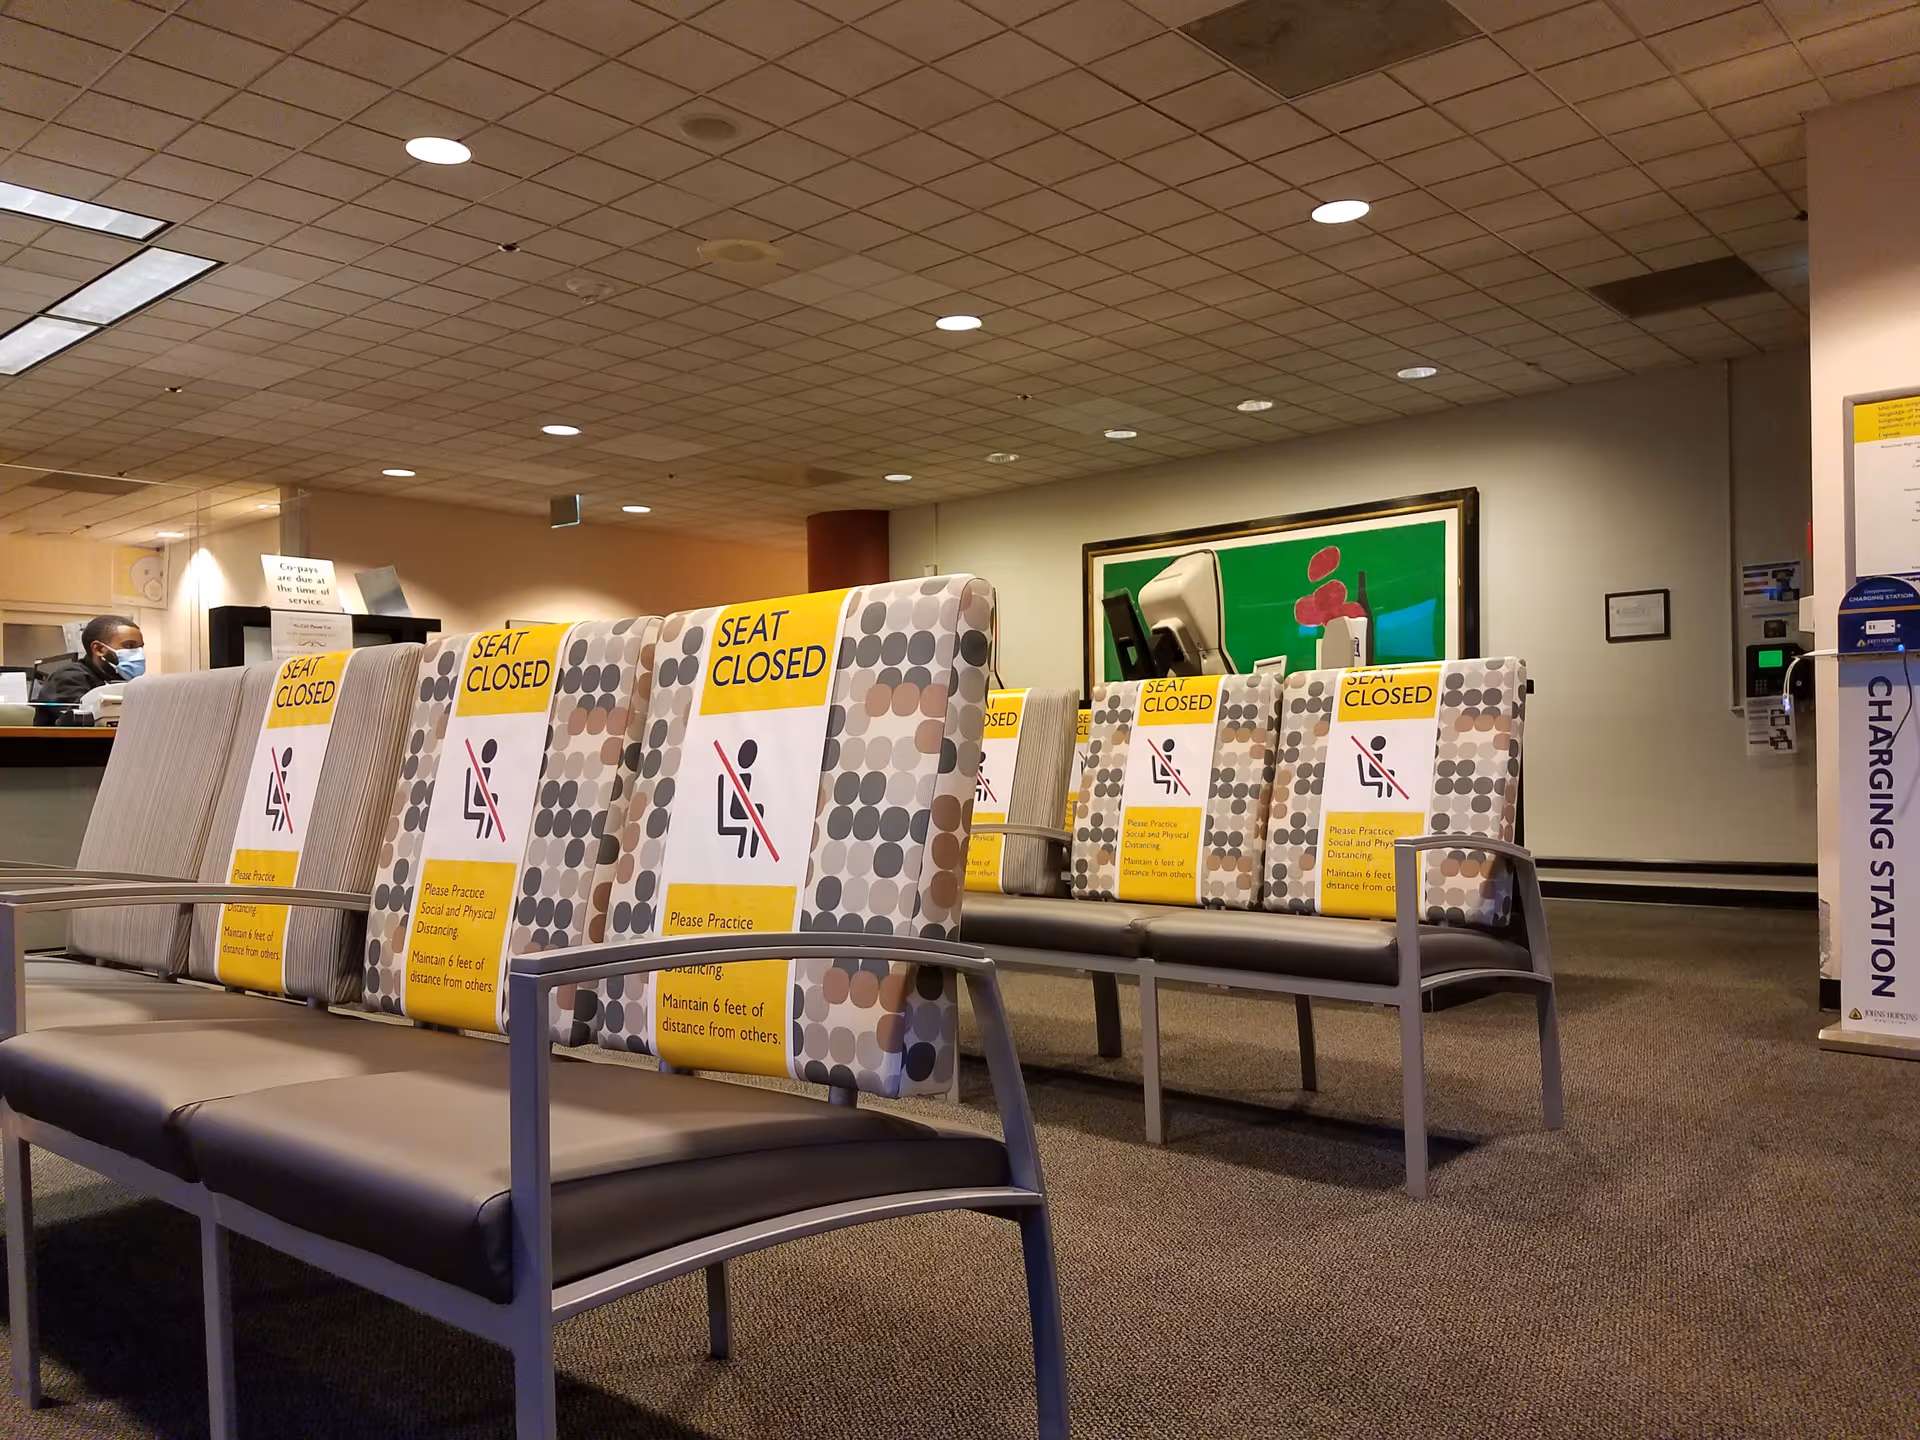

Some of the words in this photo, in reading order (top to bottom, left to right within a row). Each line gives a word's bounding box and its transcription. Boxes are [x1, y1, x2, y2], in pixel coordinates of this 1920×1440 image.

[279, 562, 319, 574] Co-pays
[296, 575, 313, 583] due
[277, 584, 293, 593] the
[296, 586, 317, 595] time
[1848, 594, 1884, 602] CHARGING
[1885, 592, 1915, 600] STATION
[718, 609, 790, 648] SEAT
[473, 631, 530, 659] SEAT
[283, 656, 326, 679] SEAT
[712, 645, 827, 687] CLOSED
[466, 660, 550, 692] CLOSED
[1346, 667, 1402, 686] SEAT
[276, 680, 336, 708] CLOSED
[1145, 678, 1190, 694] SEAT
[1143, 694, 1213, 713] CLOSED
[1344, 685, 1433, 707] CLOSED
[984, 711, 1018, 727] OSED
[1078, 713, 1091, 724] SE
[1868, 675, 1895, 850] CHARGING
[1127, 819, 1148, 827] Please
[1150, 820, 1178, 828] Practice
[1329, 826, 1356, 835] Please
[1359, 826, 1394, 836] Practice
[1126, 829, 1146, 838] Social
[1162, 831, 1190, 840] Physical
[1328, 838, 1353, 847] Social
[1356, 839, 1371, 847] and
[1374, 839, 1395, 850] Phys
[1123, 857, 1152, 865] Maintain
[1161, 859, 1175, 867] feet
[1177, 859, 1185, 867] of
[234, 869, 251, 881] Please
[252, 870, 276, 882] Practice
[1123, 868, 1150, 877] distance
[1151, 869, 1168, 877] from
[1326, 868, 1363, 878] Maintain
[1366, 870, 1371, 878] 6
[1374, 870, 1392, 879] feet
[424, 882, 449, 896] Please
[451, 884, 485, 899] Practice
[1326, 881, 1360, 891] distance
[1362, 882, 1383, 892] from
[420, 902, 445, 916] Social
[446, 904, 461, 917] and
[462, 905, 497, 921] Physical
[669, 911, 704, 928] Please
[707, 912, 754, 930] Practice
[1869, 860, 1896, 998] STATION
[224, 926, 247, 939] Maintain
[248, 929, 253, 940] 6
[254, 929, 266, 941] feet
[267, 931, 275, 942] of
[416, 920, 459, 940] Distancing.
[223, 944, 244, 956] distance
[245, 945, 259, 957] from
[260, 948, 281, 960] others.
[412, 950, 446, 965] Maintain
[448, 955, 454, 967] 6
[456, 955, 473, 970] feet
[475, 957, 486, 971] of
[410, 970, 442, 986] distance
[443, 974, 463, 989] from
[464, 978, 495, 993] others.
[662, 992, 709, 1012] Maintain
[713, 998, 720, 1013] 6
[724, 998, 748, 1016] feet
[751, 1002, 765, 1018] of
[662, 1017, 705, 1036] distance
[709, 1021, 736, 1040] from
[739, 1026, 781, 1045] others.
